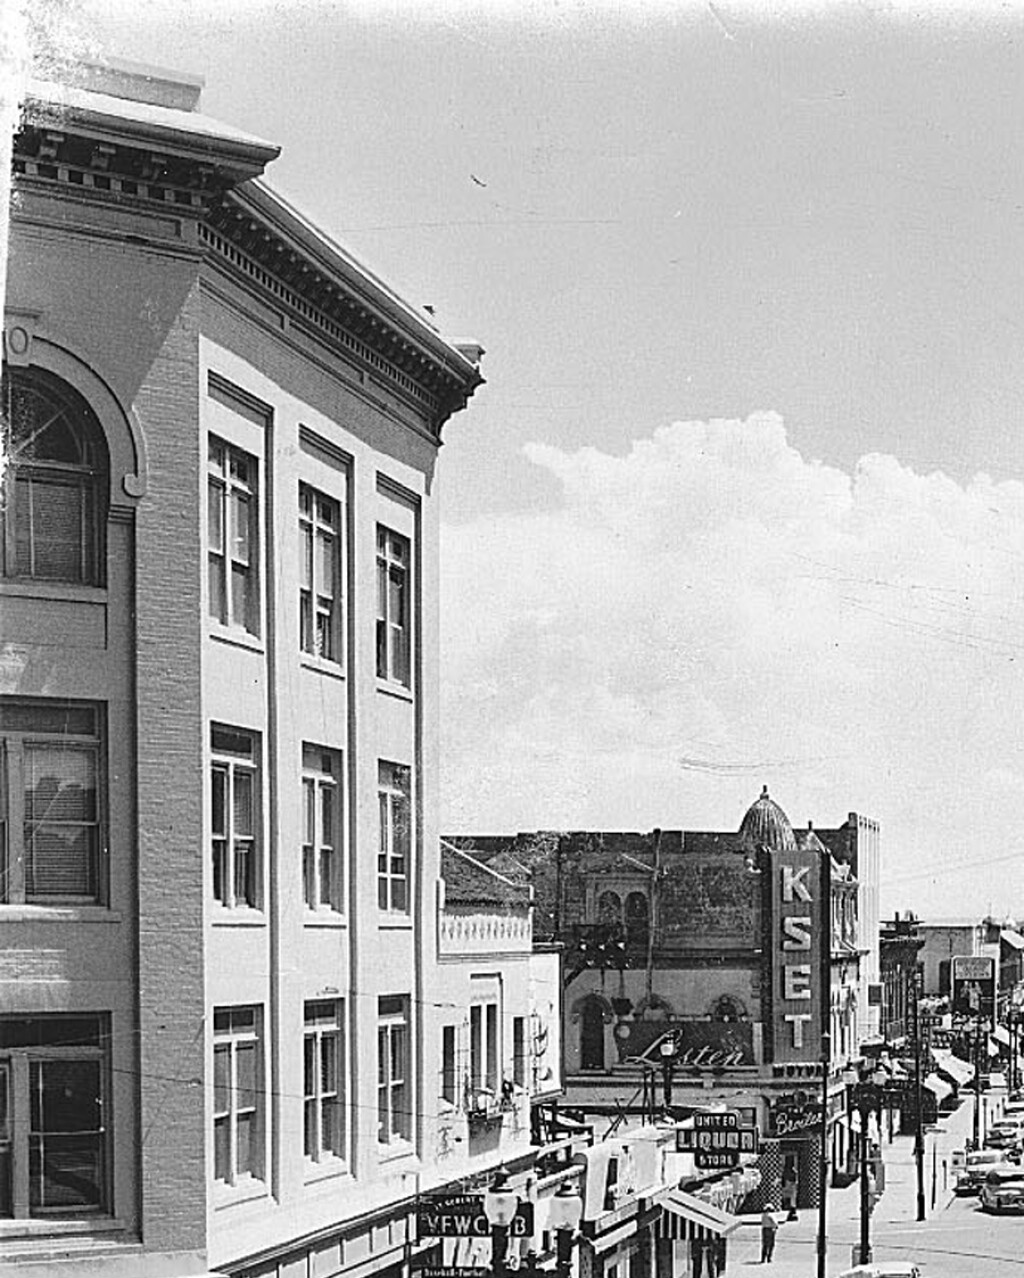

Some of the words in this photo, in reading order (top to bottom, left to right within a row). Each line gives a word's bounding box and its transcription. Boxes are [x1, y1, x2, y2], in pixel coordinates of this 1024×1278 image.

[782, 865, 814, 1048] KSET
[623, 1028, 744, 1065] Lsten
[695, 1114, 737, 1127] UNITED
[678, 1130, 754, 1151] LIQUOR
[473, 1214, 526, 1236] CB
